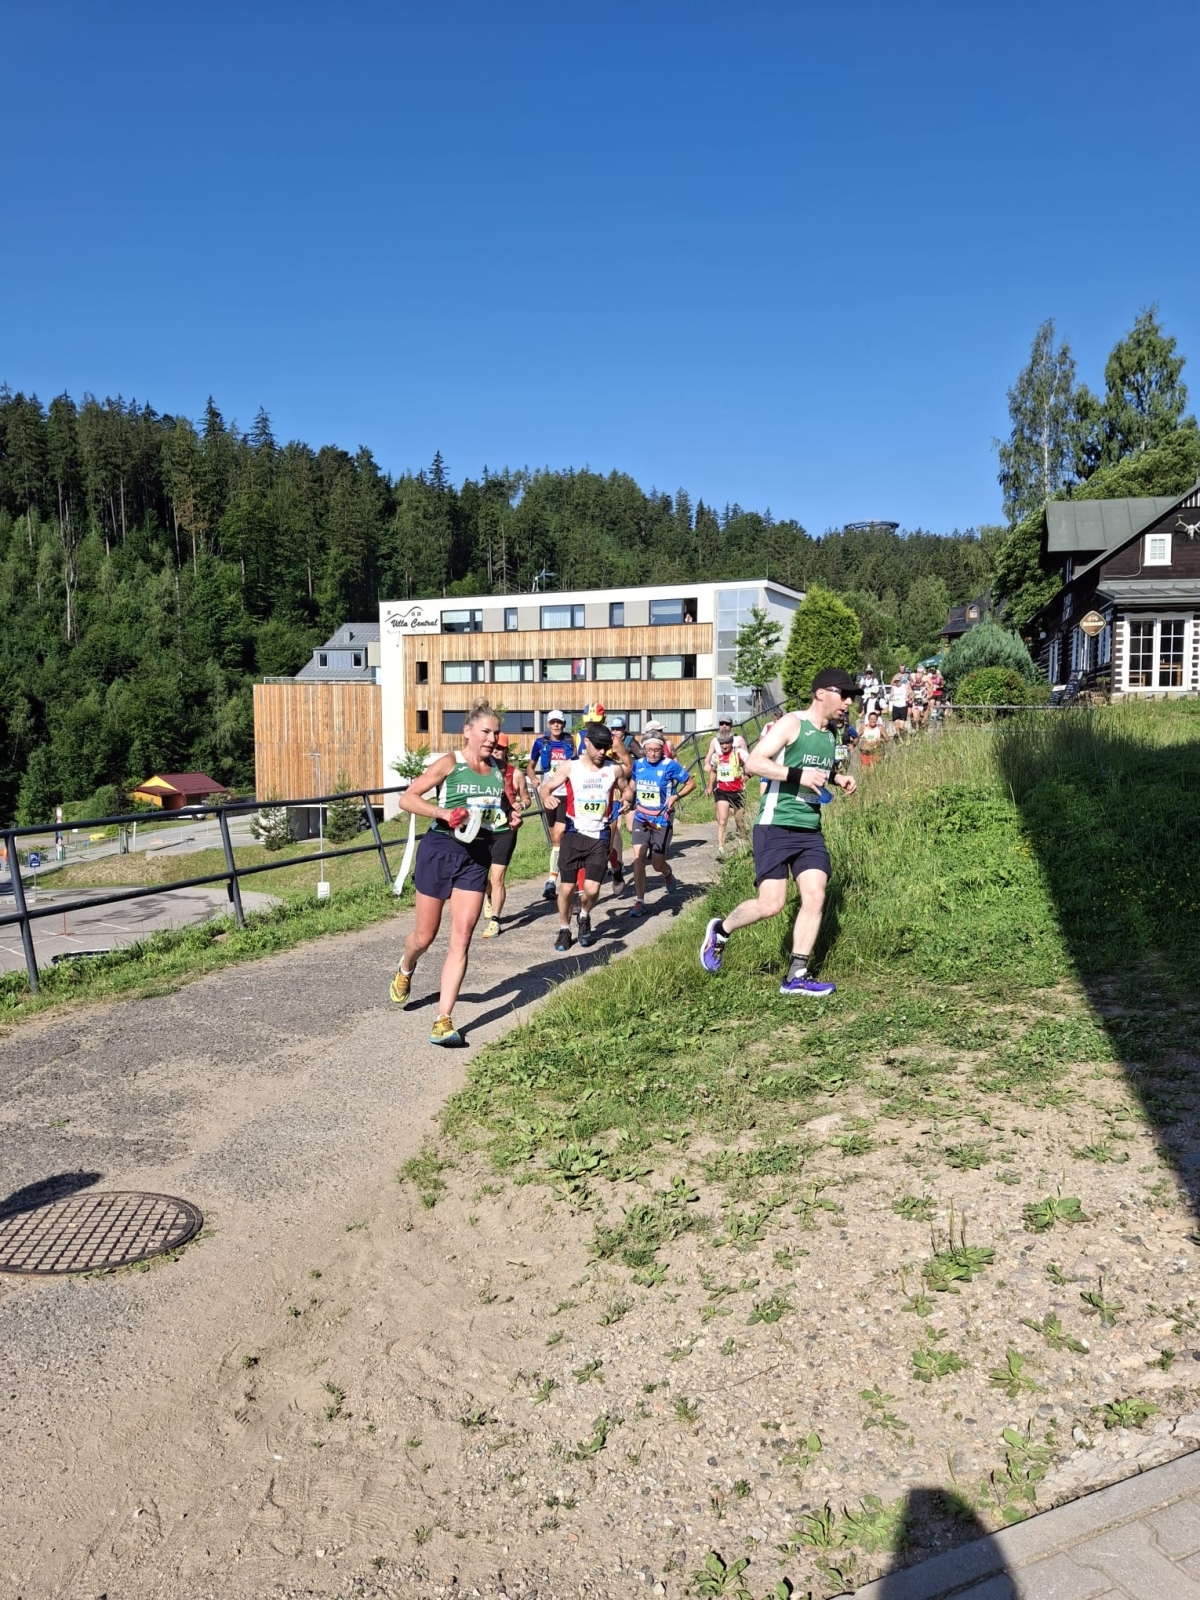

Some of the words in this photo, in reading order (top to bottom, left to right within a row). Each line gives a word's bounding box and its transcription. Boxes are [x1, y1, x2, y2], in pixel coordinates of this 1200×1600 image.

[391, 619, 408, 628] Villa
[411, 618, 439, 628] Central
[584, 803, 601, 811] 637
